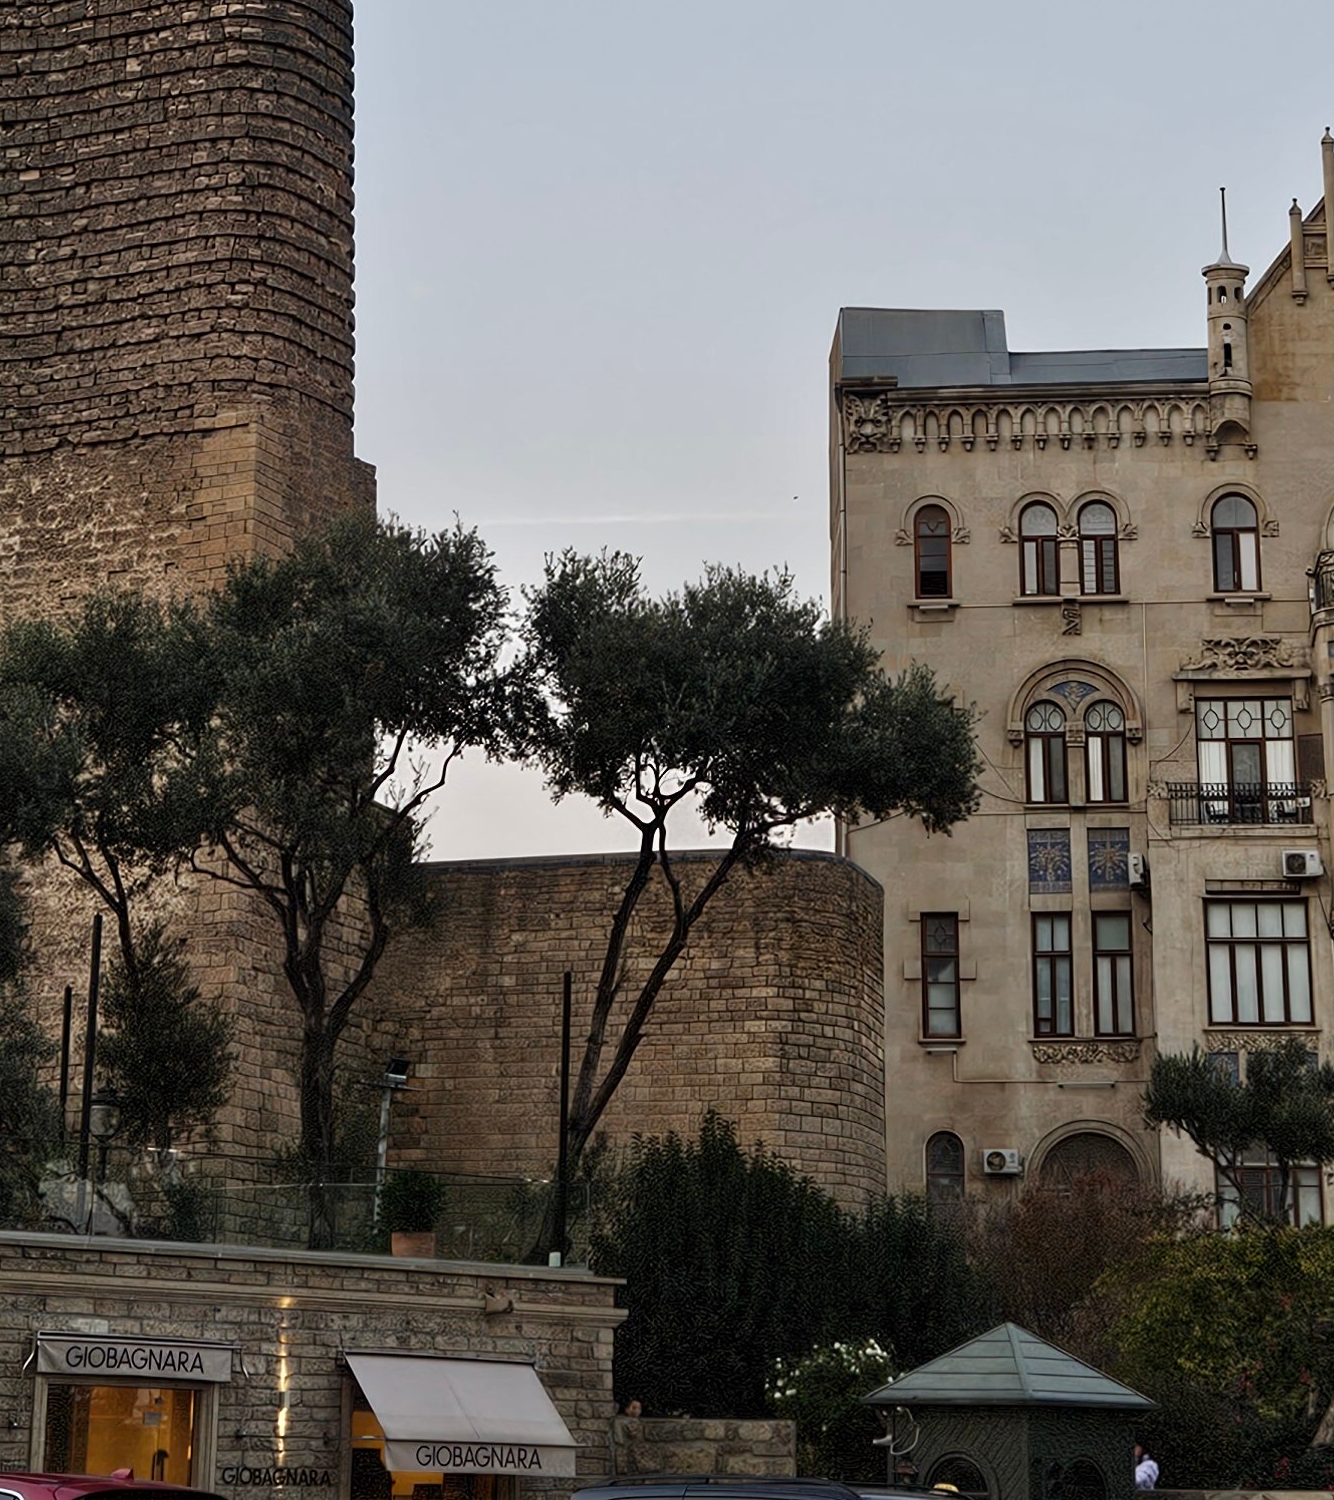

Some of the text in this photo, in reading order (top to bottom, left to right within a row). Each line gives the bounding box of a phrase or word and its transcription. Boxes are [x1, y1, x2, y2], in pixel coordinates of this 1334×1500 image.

[65, 1346, 204, 1374] GIOBAGNARA
[416, 1445, 542, 1469] GIOBAGNARA
[222, 1466, 331, 1486] GIOBAGNARA
